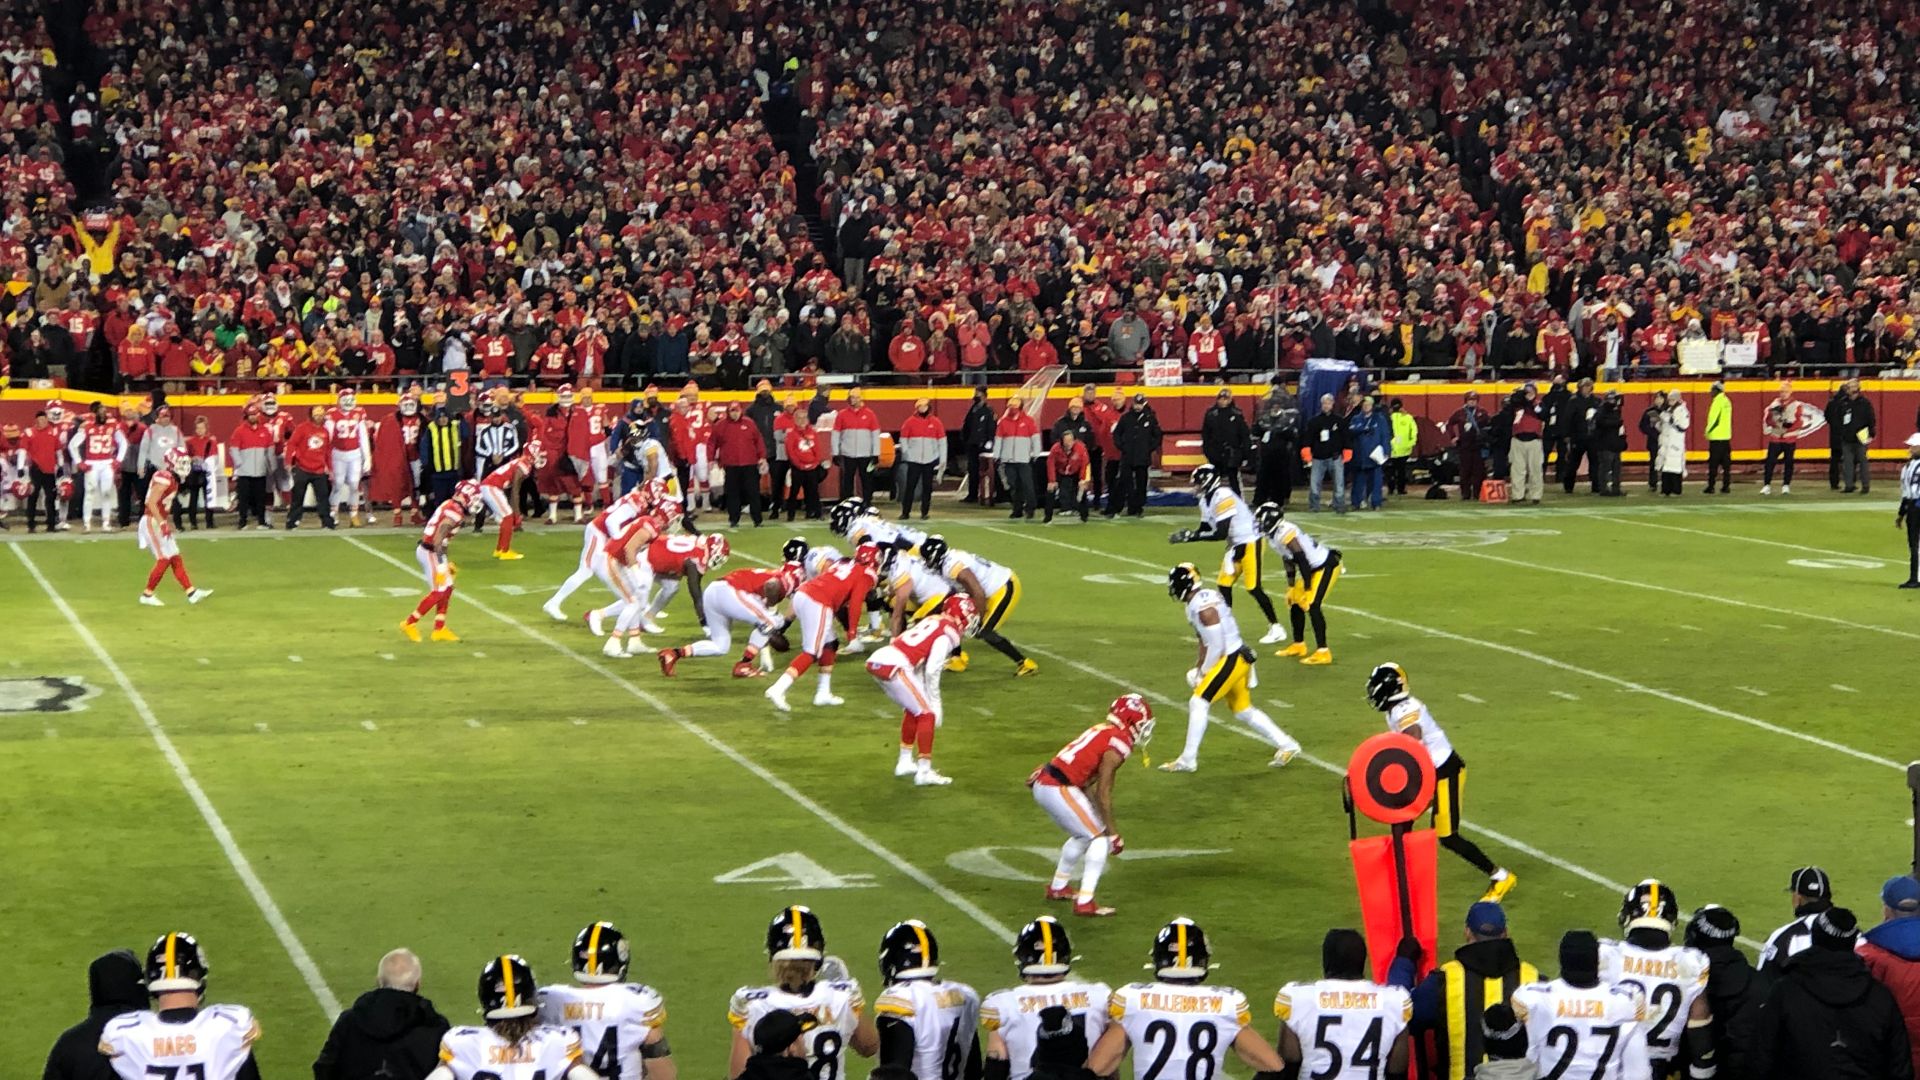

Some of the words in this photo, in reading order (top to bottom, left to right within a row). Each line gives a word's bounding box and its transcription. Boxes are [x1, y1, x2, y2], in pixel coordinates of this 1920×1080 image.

[69, 317, 83, 334] 15
[488, 341, 504, 357] 15
[547, 353, 563, 370] 15
[450, 371, 470, 397] 3
[336, 419, 359, 439] 97
[1487, 482, 1507, 500] 20
[1623, 956, 1679, 979] HARRIS
[1018, 992, 1091, 1014] SPILLANE
[1139, 992, 1224, 1013] KILLEBREW
[1319, 991, 1379, 1010] GILBERT
[1556, 999, 1605, 1019] ALLEN
[563, 1002, 605, 1021] WATT
[153, 1034, 198, 1058] HAEG
[1143, 1019, 1218, 1080] 28
[1310, 1015, 1384, 1080] 54
[1536, 1023, 1621, 1080] 27
